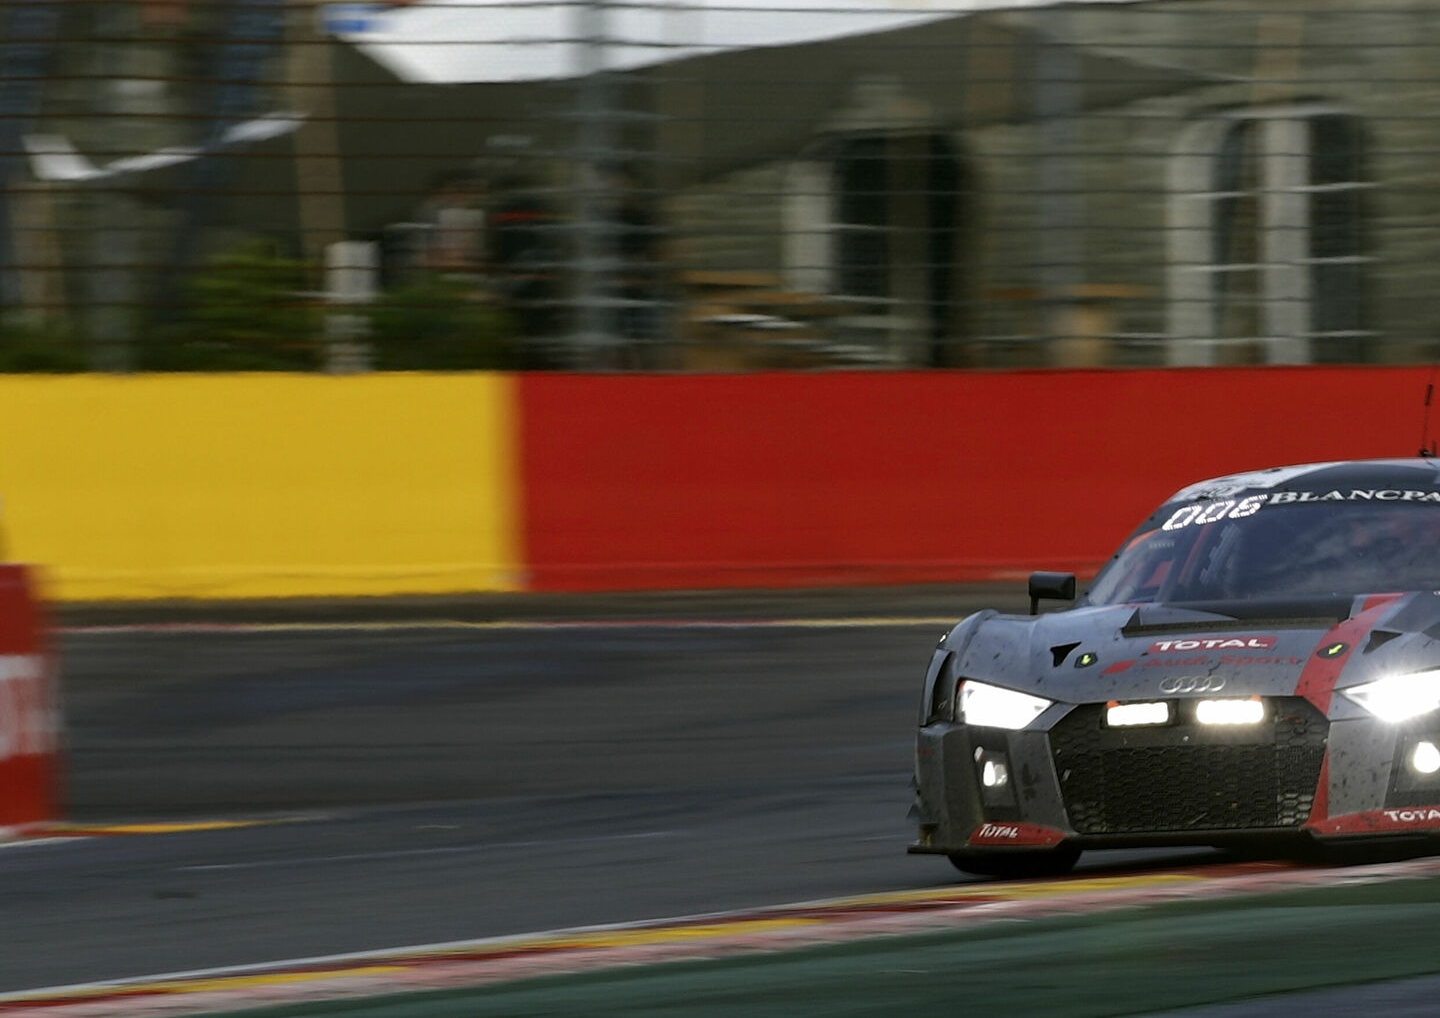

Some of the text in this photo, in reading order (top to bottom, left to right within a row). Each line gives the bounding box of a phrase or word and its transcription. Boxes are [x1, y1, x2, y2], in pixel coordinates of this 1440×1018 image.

[1162, 494, 1268, 531] 006
[1155, 638, 1268, 652] TOTAL
[1142, 654, 1301, 670] Audi Sport
[979, 823, 1019, 839] TOTAL
